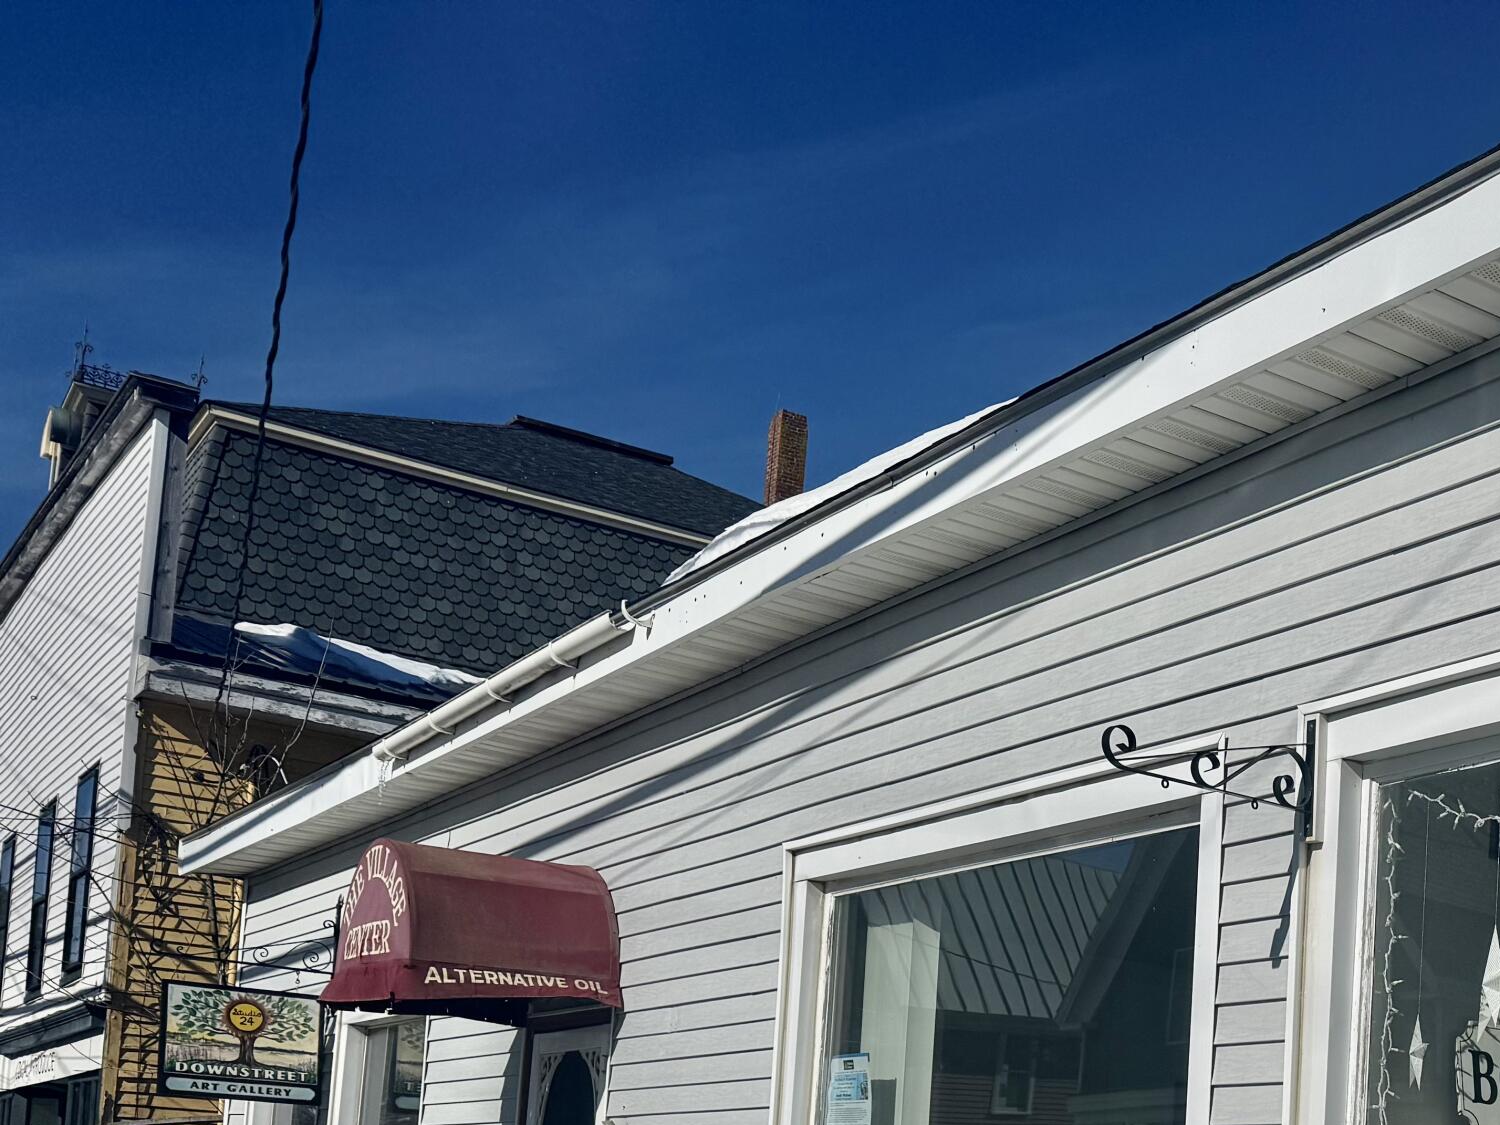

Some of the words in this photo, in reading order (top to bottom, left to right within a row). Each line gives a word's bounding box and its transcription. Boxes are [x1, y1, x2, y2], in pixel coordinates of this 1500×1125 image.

[343, 864, 365, 928] THE
[365, 844, 407, 927] VILLAGE
[344, 919, 391, 961] CENTER
[424, 966, 569, 990] ALTERNATIVE
[573, 979, 609, 995] OIL
[231, 1007, 262, 1018] Studio
[240, 1016, 255, 1027] 24
[175, 1061, 309, 1083] DOWNSTREET
[190, 1081, 220, 1092] ART
[227, 1084, 292, 1097] GALLERY
